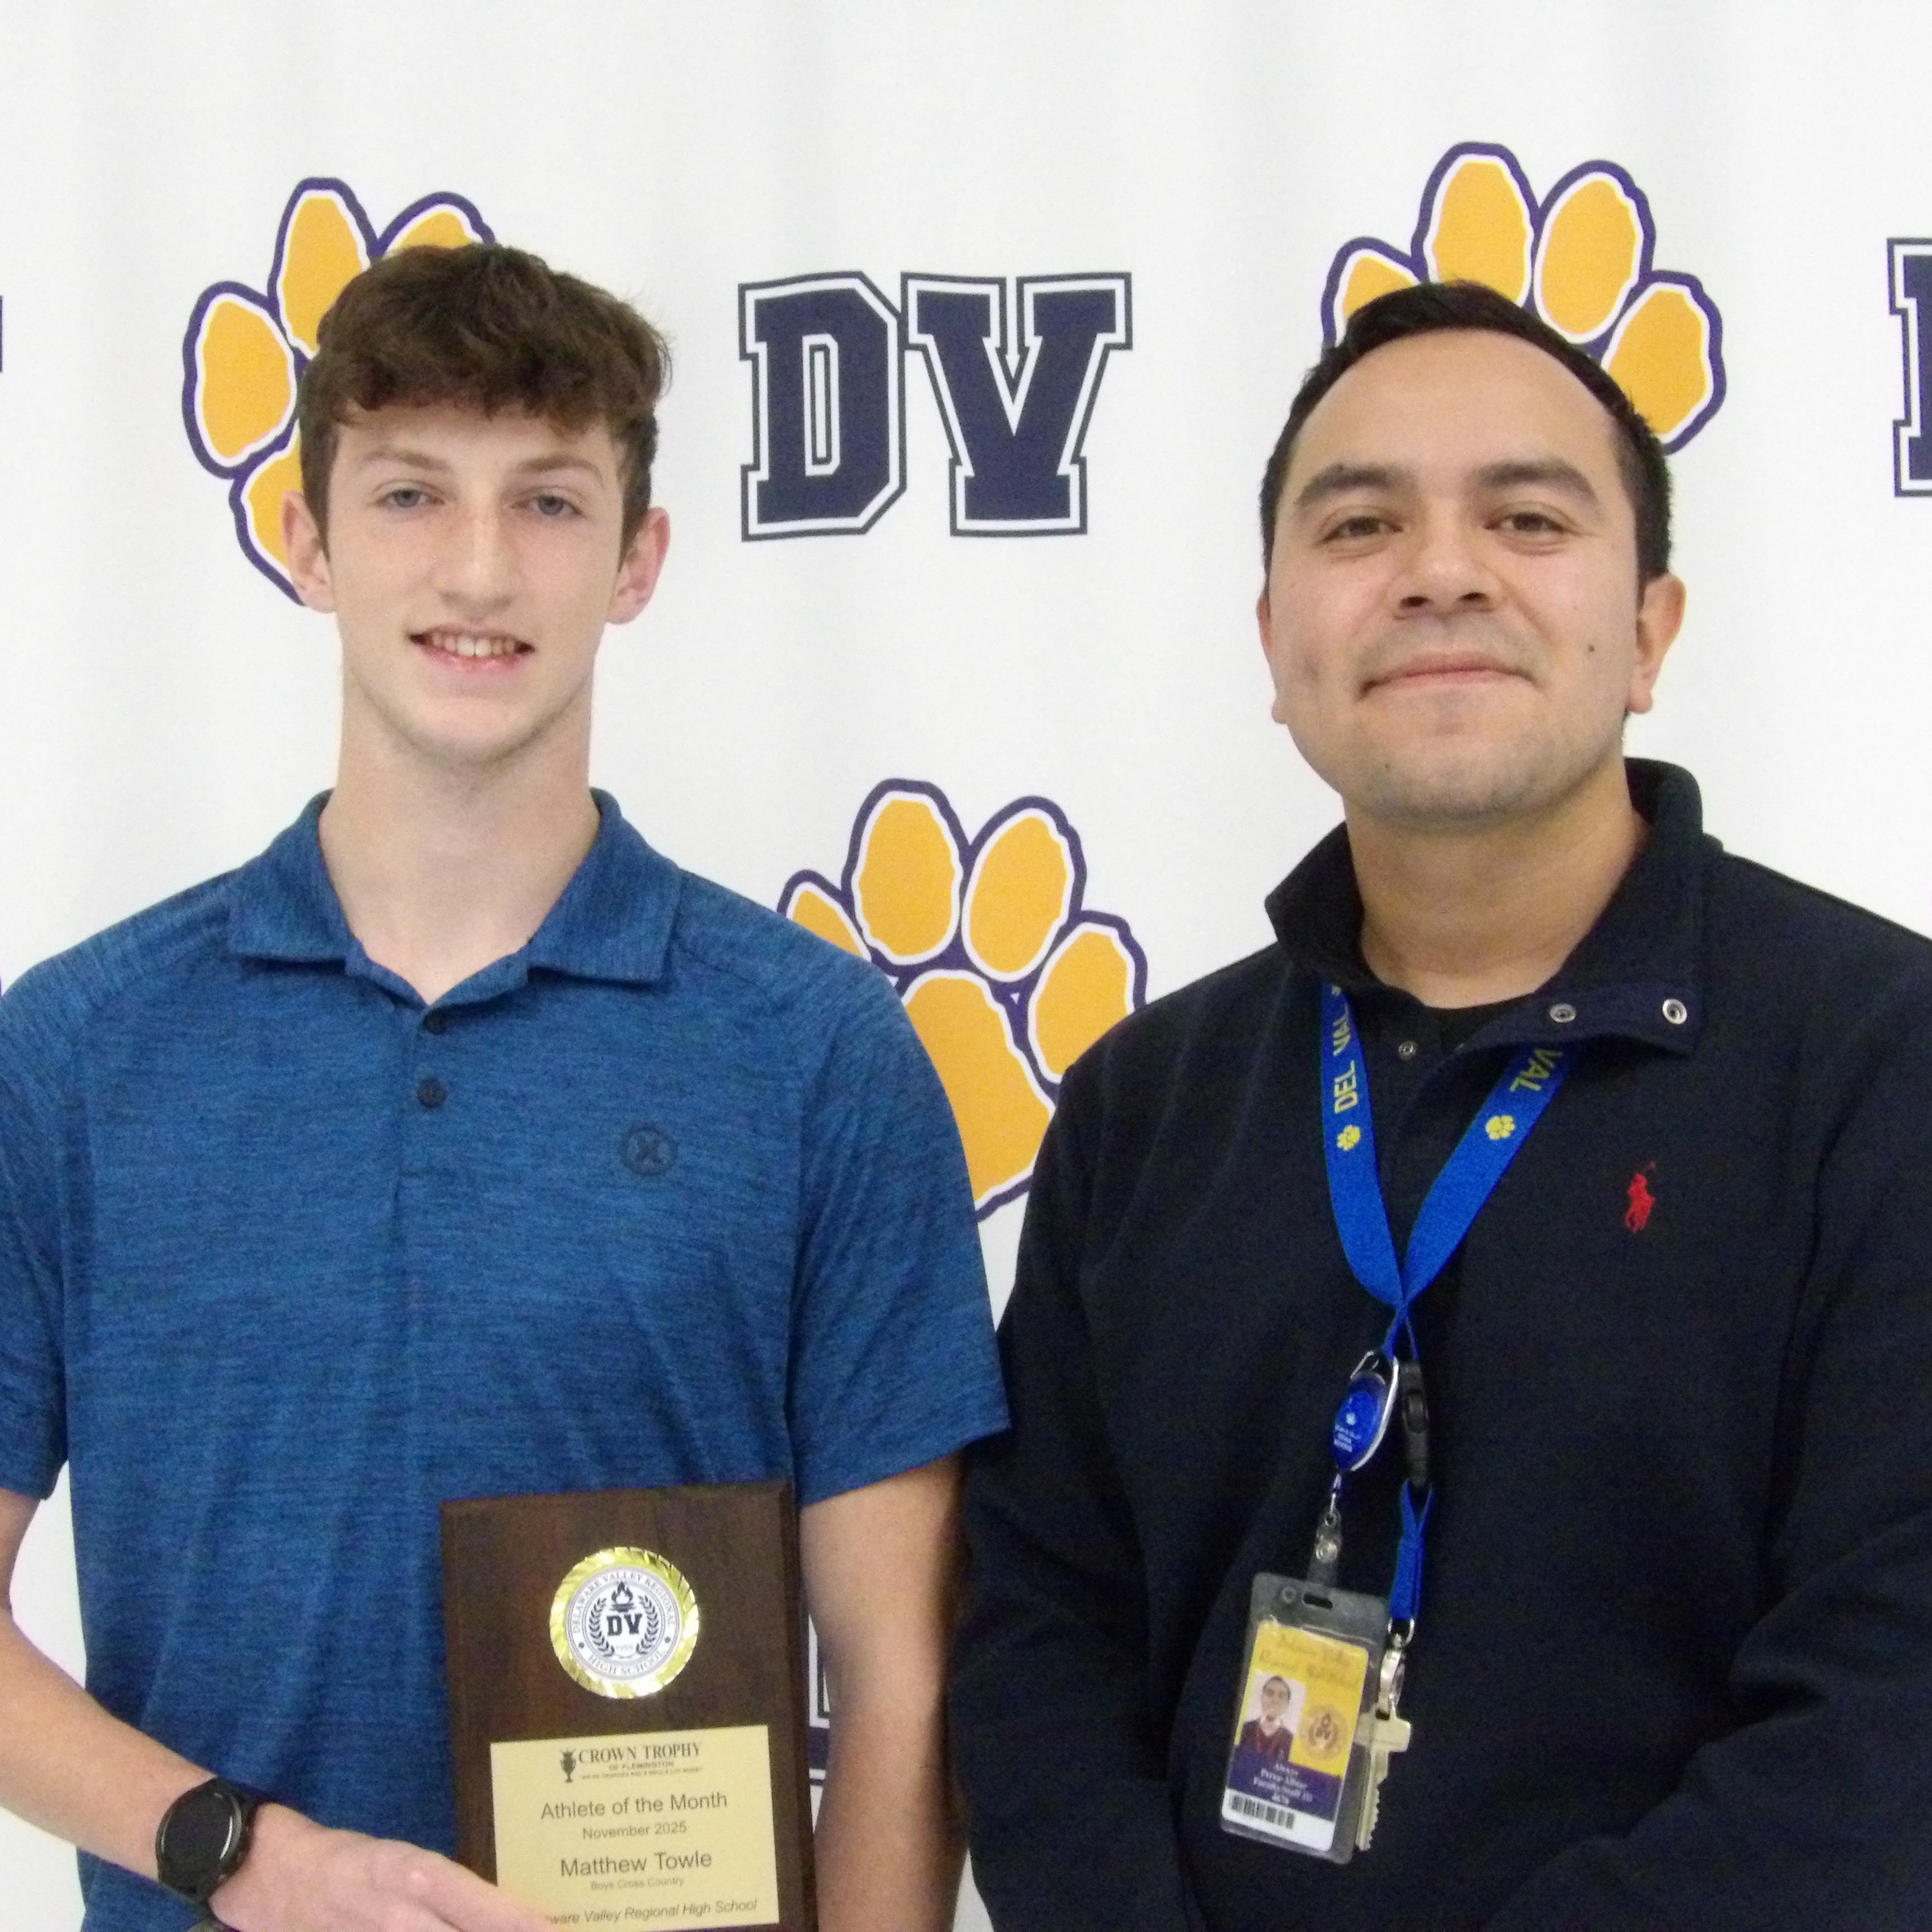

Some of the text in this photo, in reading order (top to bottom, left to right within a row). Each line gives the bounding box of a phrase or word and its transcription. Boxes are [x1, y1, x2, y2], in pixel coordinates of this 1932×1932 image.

[738, 271, 1133, 542] DV
[1509, 1048, 1563, 1092] VAL
[1334, 1060, 1359, 1114] DEL
[606, 1613, 642, 1636] DV
[579, 1741, 701, 1764] CROWN TROPHY
[541, 1792, 727, 1820] Athlete of the Month
[583, 1821, 687, 1840] November 2025
[561, 1850, 712, 1877] Matthew Towle
[591, 1876, 684, 1891] Boys Cross Country
[584, 1908, 621, 1924] Valley
[624, 1903, 680, 1921] Regional
[683, 1902, 711, 1918] High
[716, 1898, 757, 1914] School
